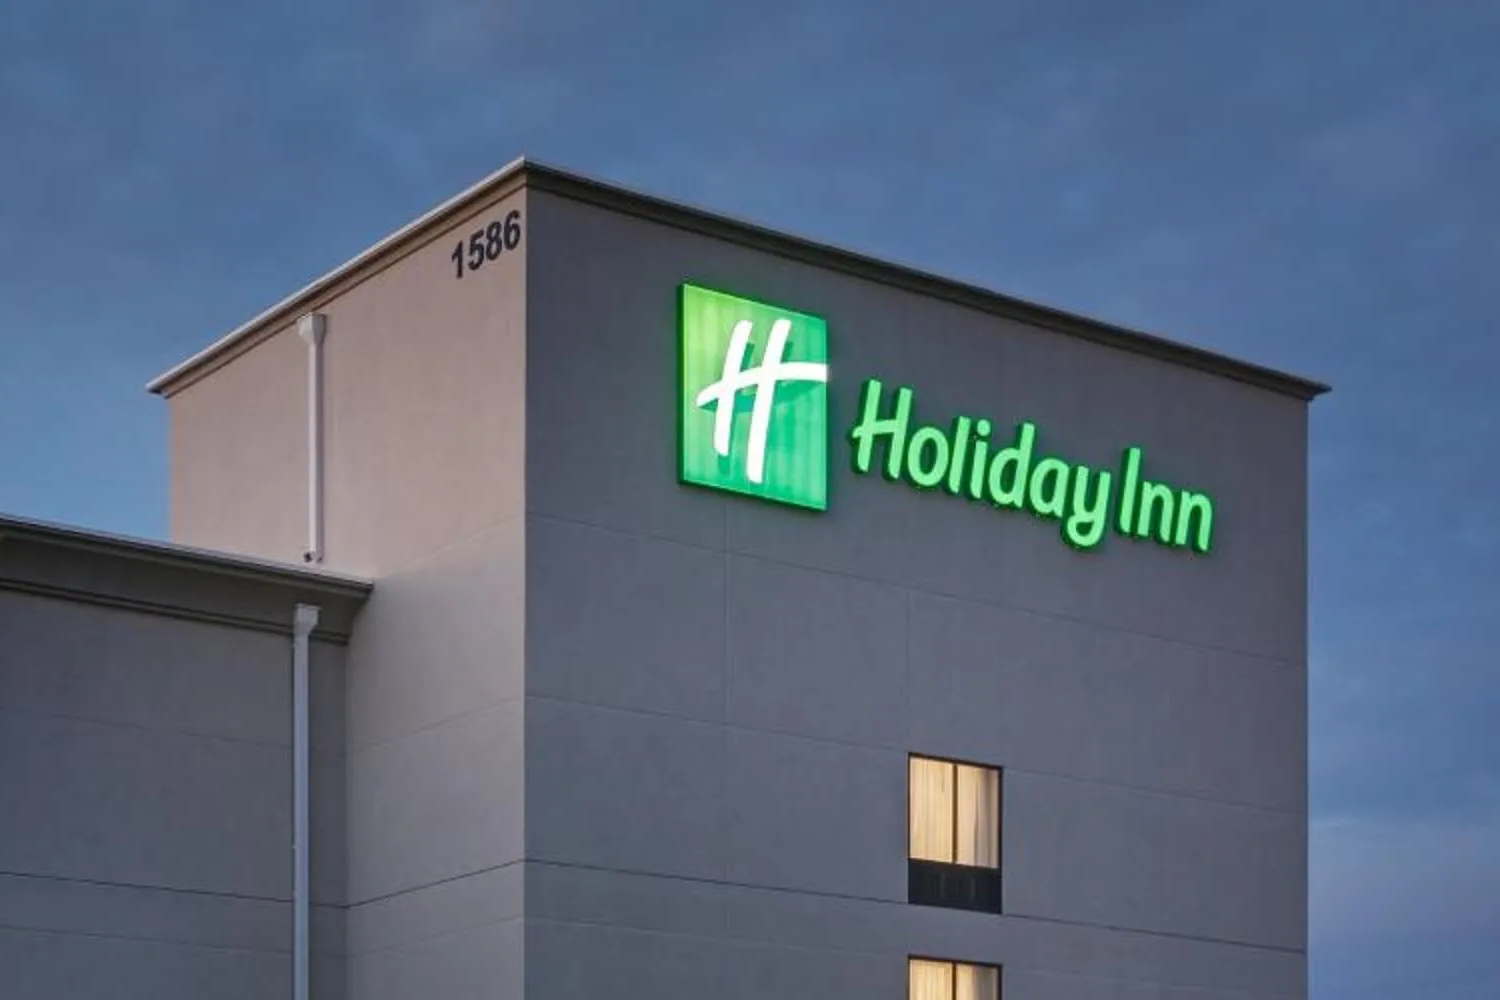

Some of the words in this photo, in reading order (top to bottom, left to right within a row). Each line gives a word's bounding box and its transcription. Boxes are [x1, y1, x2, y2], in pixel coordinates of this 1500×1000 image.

[451, 209, 521, 279] 1586
[850, 378, 1112, 547] Holiday
[1117, 446, 1214, 552] Inn
